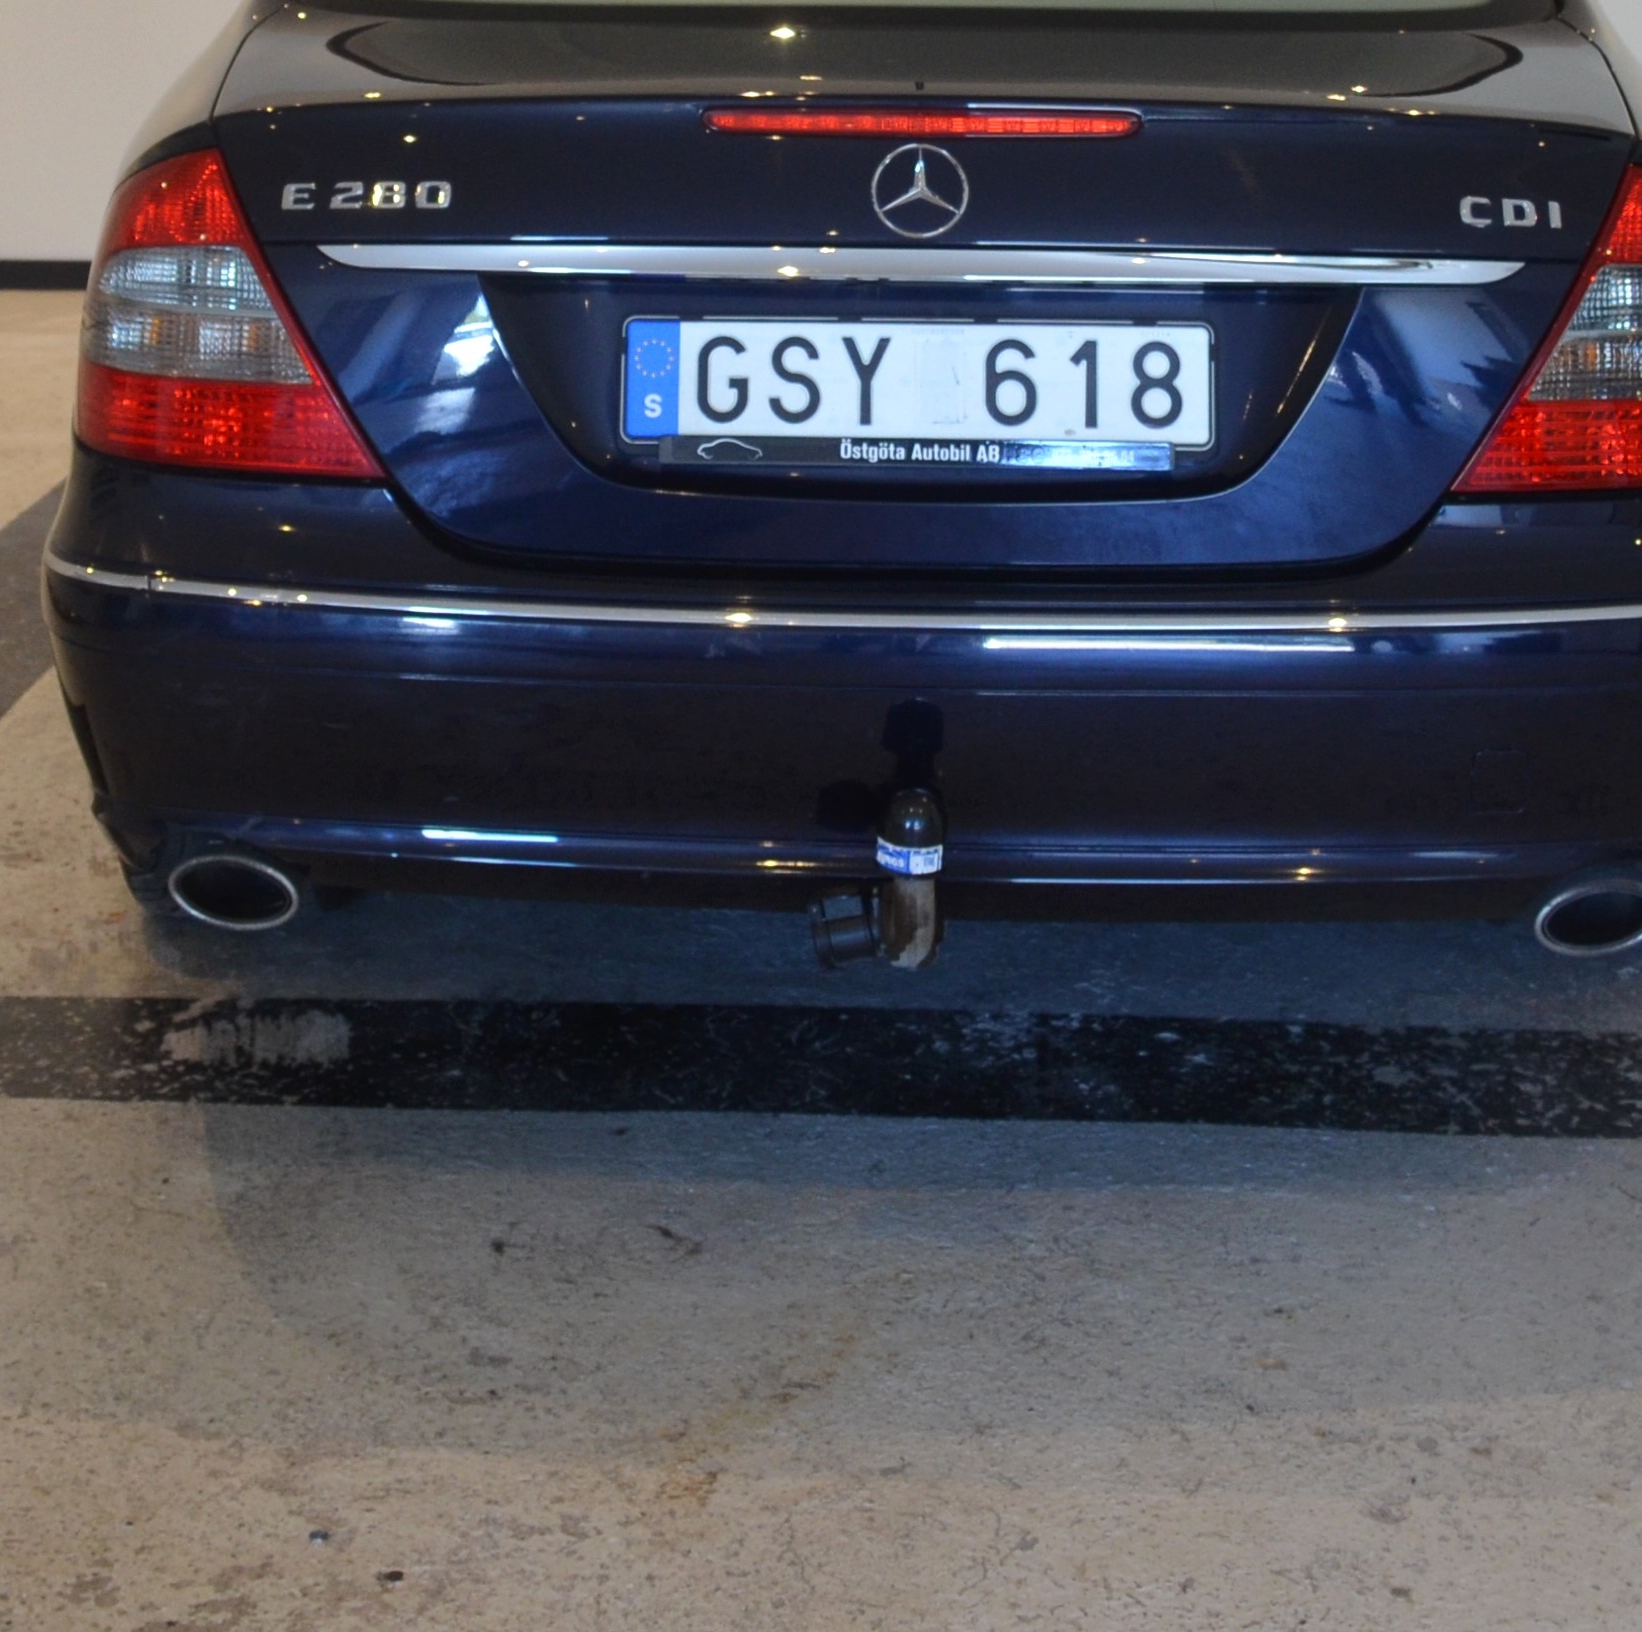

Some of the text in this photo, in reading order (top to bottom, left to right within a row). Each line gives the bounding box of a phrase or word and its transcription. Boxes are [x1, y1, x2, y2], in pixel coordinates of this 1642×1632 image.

[281, 181, 452, 210] E 280
[1459, 195, 1562, 229] CDI
[696, 335, 1183, 428] GSY 618
[643, 393, 663, 419] S
[839, 438, 906, 463] Östgöta
[911, 442, 970, 462] Autobil
[976, 443, 1000, 462] AB
